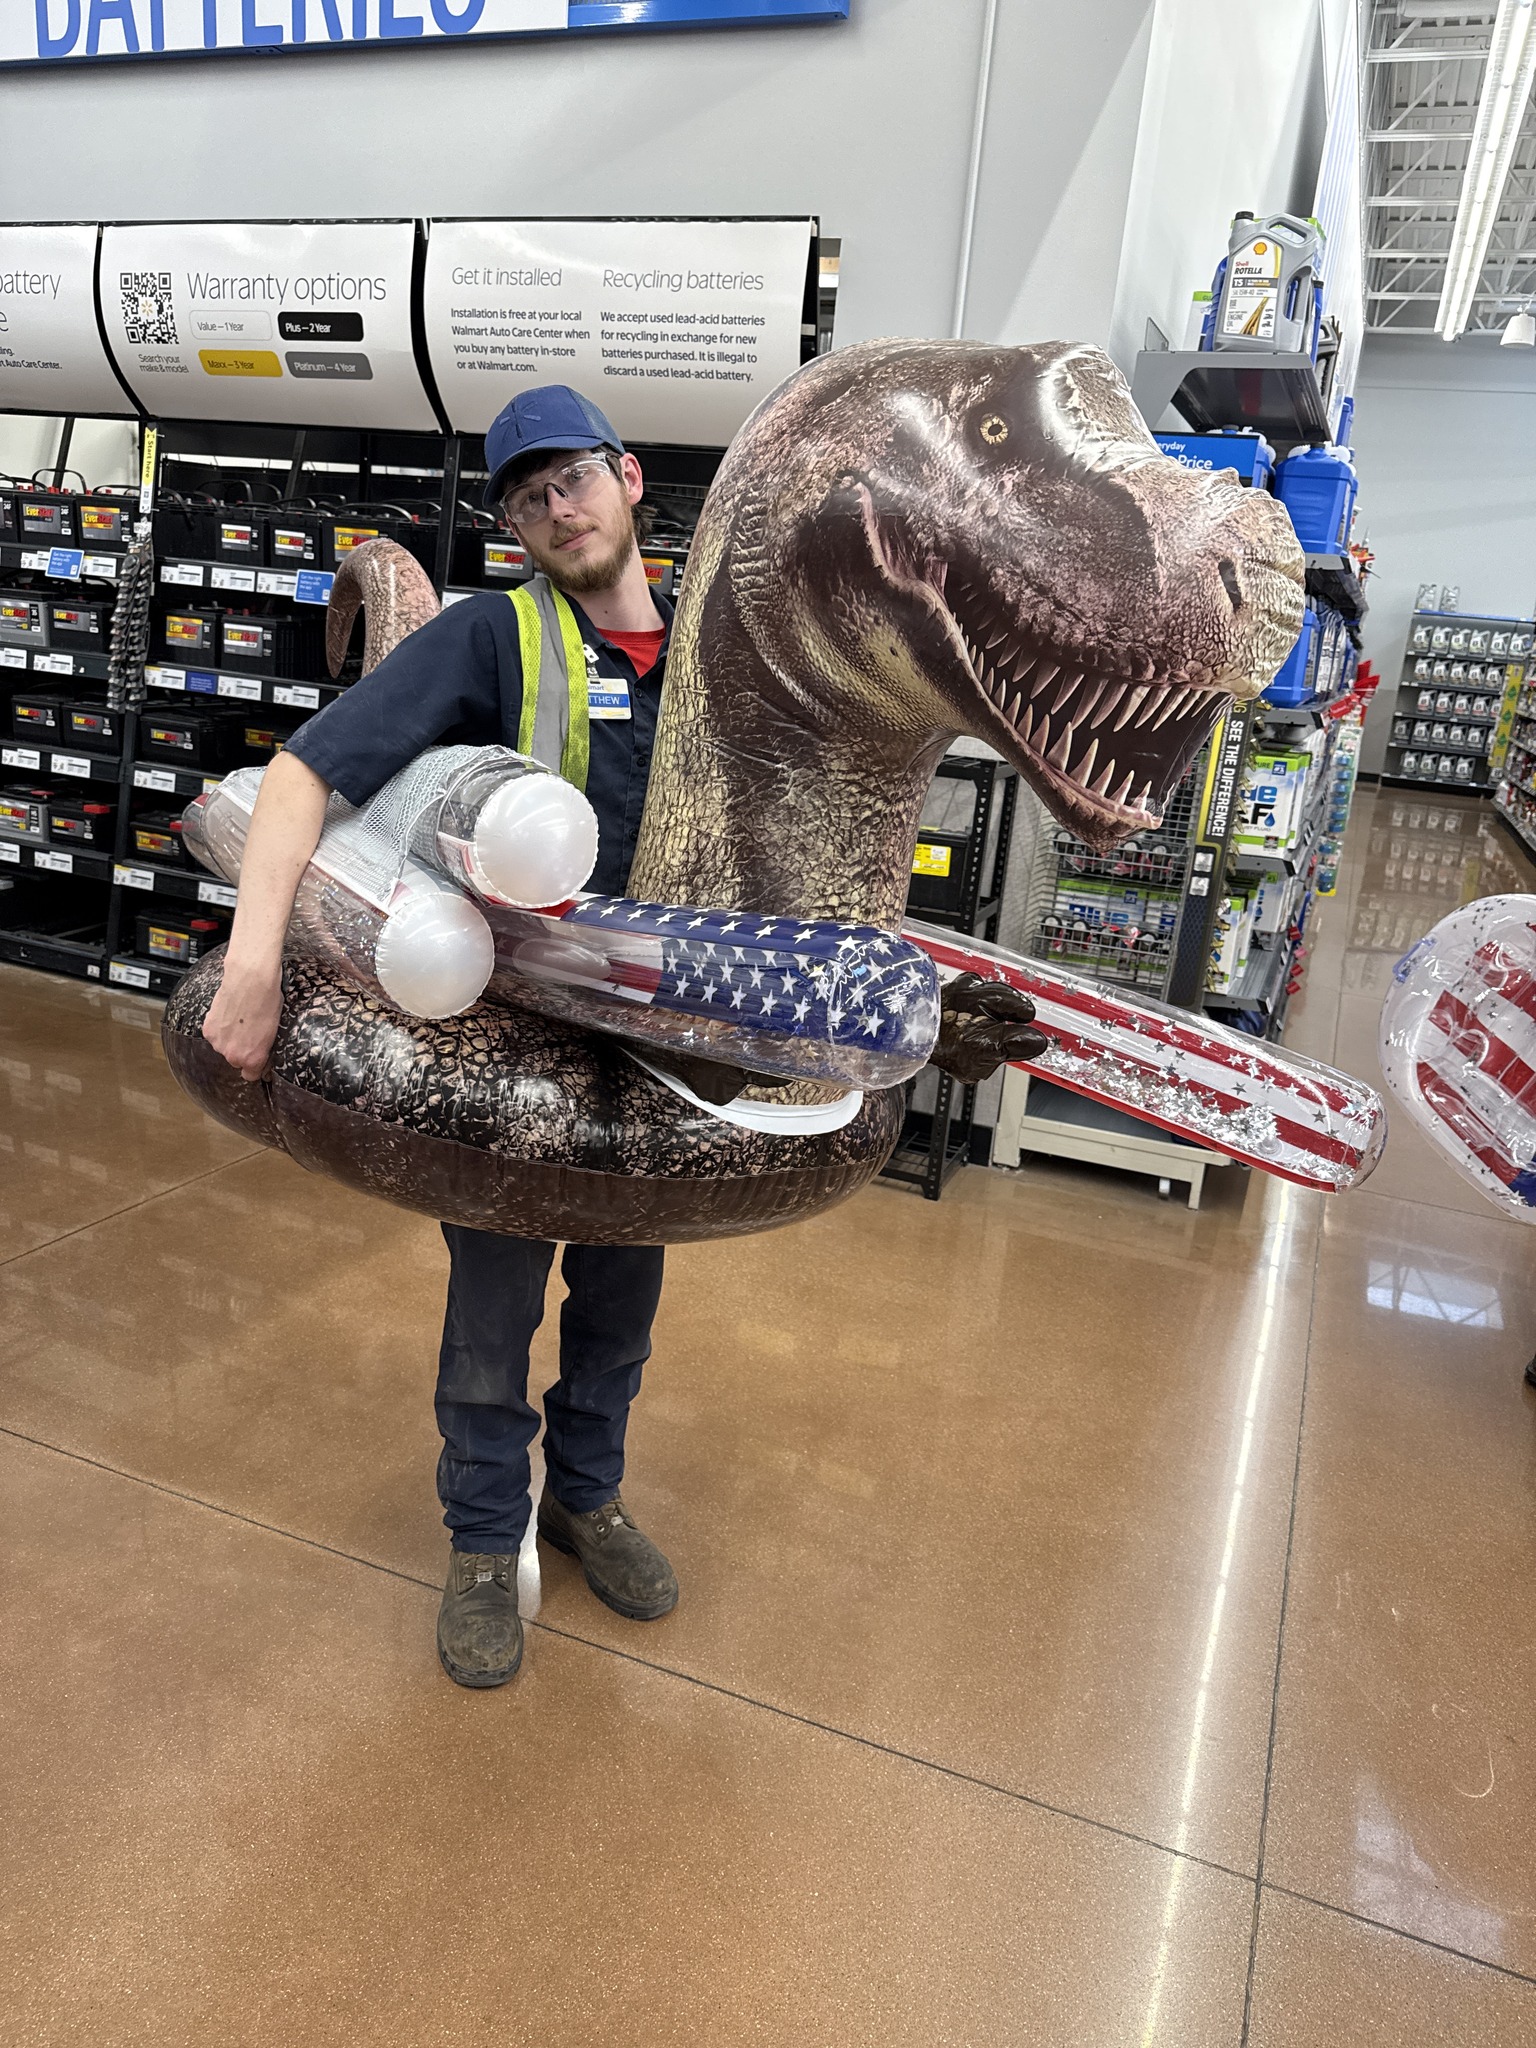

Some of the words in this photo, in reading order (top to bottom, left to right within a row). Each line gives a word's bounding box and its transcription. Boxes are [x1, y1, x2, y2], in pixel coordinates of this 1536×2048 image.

[451, 267, 480, 285] Get
[483, 268, 493, 285] it
[496, 268, 563, 287] installed
[603, 269, 683, 293] Recycling
[686, 270, 764, 291] batteries
[187, 272, 289, 305] Warranty
[294, 272, 386, 305] options
[451, 308, 498, 319] Installation
[500, 309, 507, 319] is
[508, 309, 527, 320] free
[528, 310, 537, 320] at
[538, 312, 559, 322] your
[561, 310, 582, 321] local
[600, 311, 616, 322] We
[616, 313, 649, 325] accept
[650, 313, 673, 324] used
[675, 313, 720, 325] lead-acid
[721, 314, 766, 326] batteries
[197, 322, 217, 331] Value
[229, 322, 244, 331] Year
[285, 322, 301, 333] Plus
[315, 323, 332, 333] Year
[451, 326, 488, 337] Walmart
[490, 327, 511, 337] Auto
[512, 327, 532, 338] Care
[533, 328, 563, 339] Center
[564, 329, 591, 340] when
[601, 330, 614, 340] for
[616, 331, 659, 343] recycling
[660, 331, 669, 342] in
[670, 332, 718, 345] exchange
[719, 333, 734, 344] for
[735, 335, 757, 345] new
[454, 345, 470, 354] you
[471, 343, 488, 355] buy
[489, 346, 505, 356] any
[506, 345, 540, 357] battery
[540, 346, 576, 357] in-store
[601, 348, 643, 359] batteries
[644, 349, 698, 361] purchased.
[699, 351, 706, 362] It
[707, 351, 716, 362] is
[716, 352, 745, 364] illegal
[747, 353, 758, 363] to
[138, 354, 164, 363] Search
[163, 356, 181, 364] your
[207, 359, 227, 369] Maxx
[239, 361, 255, 370] Year
[139, 364, 160, 372] make
[165, 365, 190, 373] model
[294, 361, 327, 372] Platinum
[340, 363, 357, 373] Year
[457, 362, 466, 370] or
[468, 361, 477, 370] at
[478, 361, 538, 373] Walmart.com.
[603, 366, 638, 377] discard
[639, 369, 645, 377] a
[646, 367, 669, 378] used
[671, 368, 714, 380] lead-acid
[715, 370, 754, 383] battery.
[1157, 442, 1186, 452] eryday
[1178, 455, 1213, 469] Price
[25, 505, 54, 518] EverStart
[84, 512, 113, 524] EverStart
[224, 530, 250, 540] EverStart
[277, 536, 304, 546] EverStart
[489, 551, 525, 564] EverStart
[169, 622, 198, 634] EverStart
[227, 630, 259, 642] EverStart
[588, 695, 620, 705] TTHEW
[1228, 720, 1244, 742] SEE
[1224, 745, 1240, 766] THE
[1211, 767, 1237, 837] DIFFERENCE!
